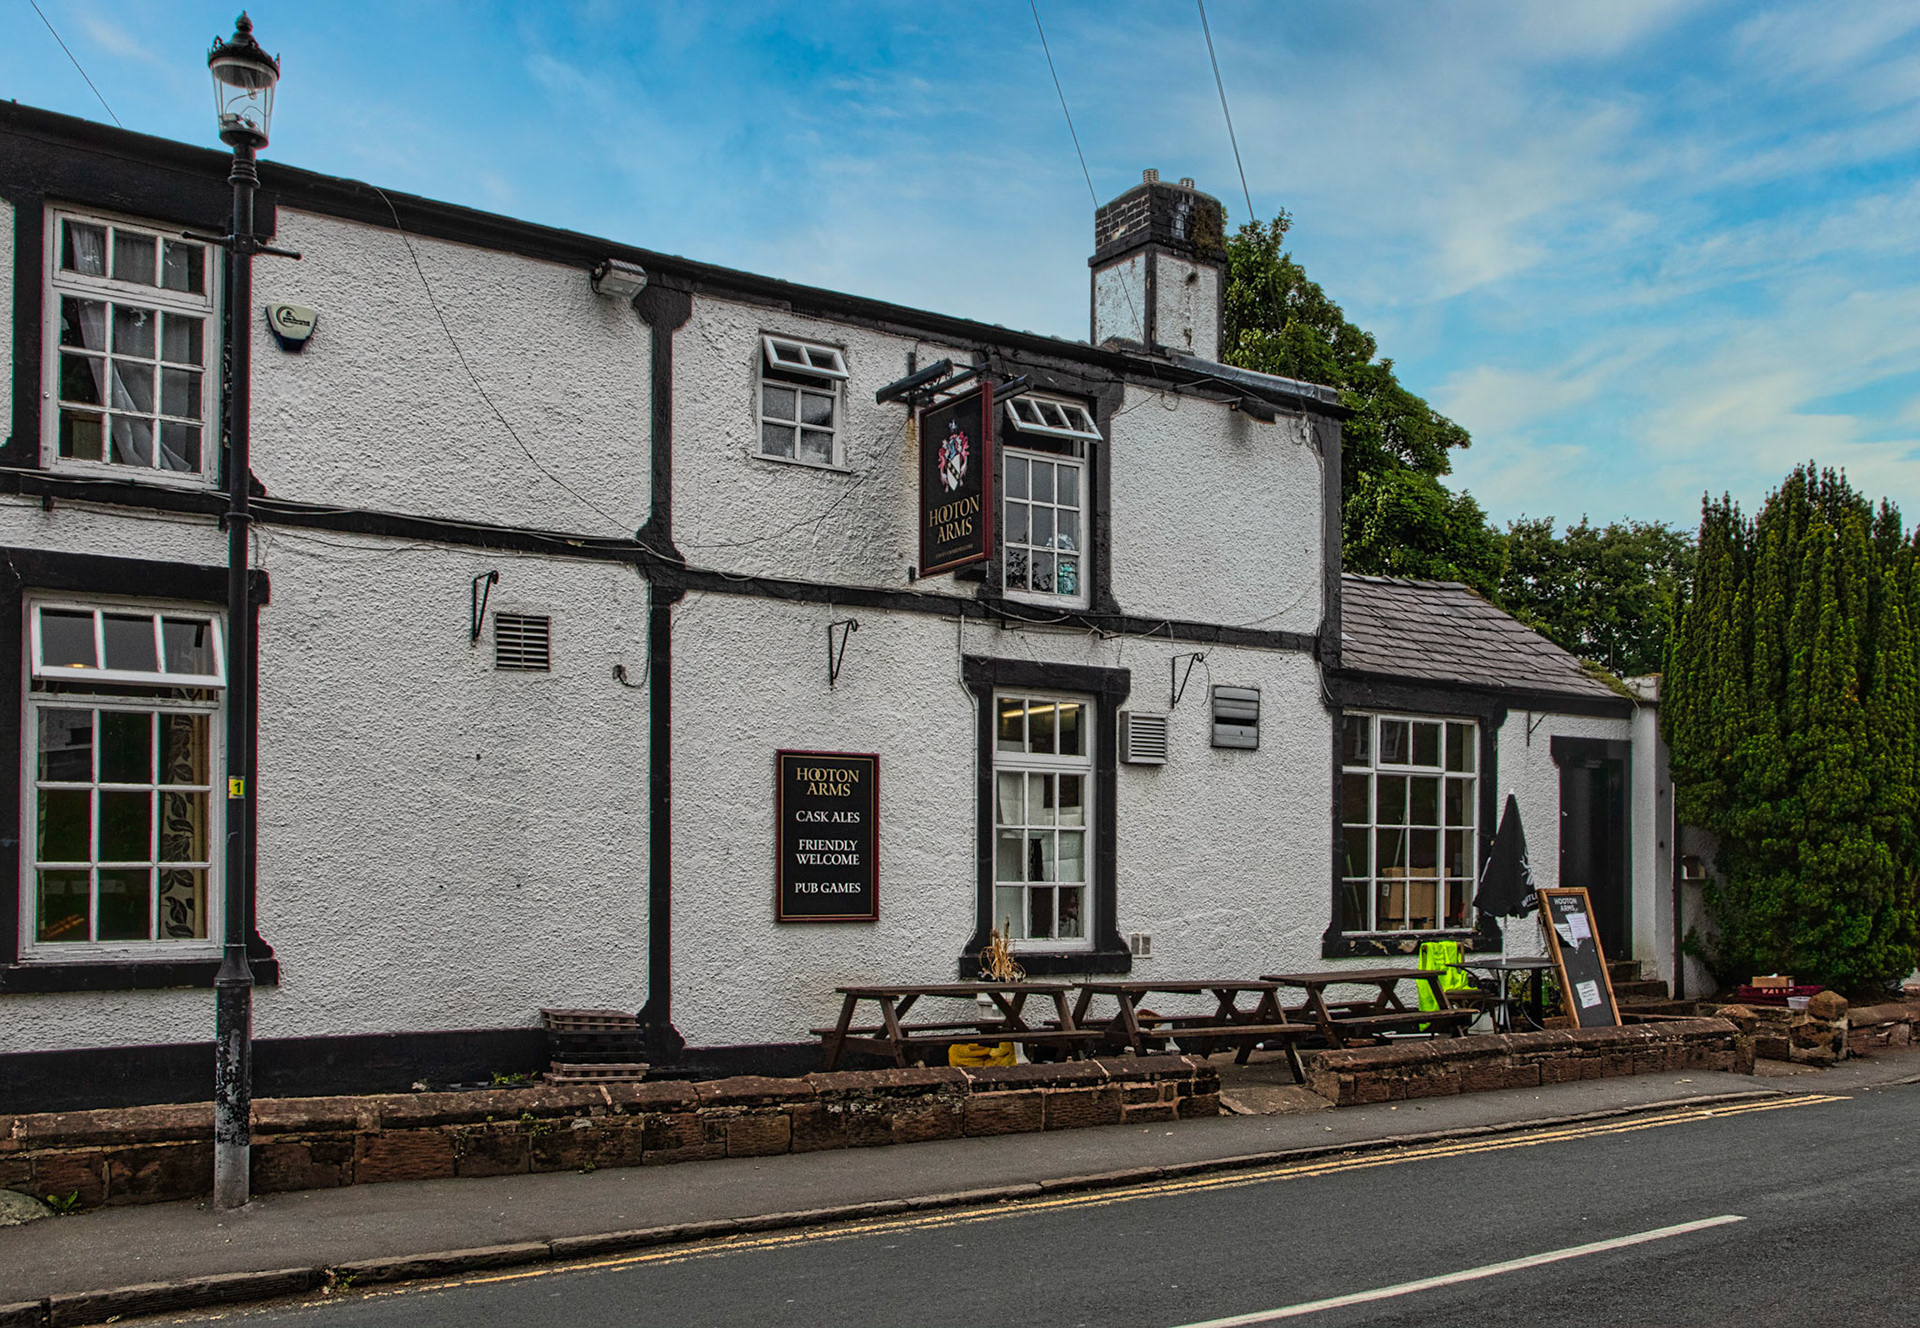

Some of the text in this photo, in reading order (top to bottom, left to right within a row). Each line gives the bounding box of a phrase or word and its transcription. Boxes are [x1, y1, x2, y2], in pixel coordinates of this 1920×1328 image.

[929, 494, 980, 528] HOOTON
[937, 516, 973, 544] ARMS
[796, 767, 860, 783] HOOTON
[234, 781, 241, 794] 1
[806, 782, 851, 797] ARMS
[795, 810, 861, 823] CASK ALES
[798, 838, 858, 851] FRIENDLY
[796, 853, 860, 865] WELCOME
[794, 882, 861, 894] PUB GAMES
[1553, 897, 1578, 905] HOOTON
